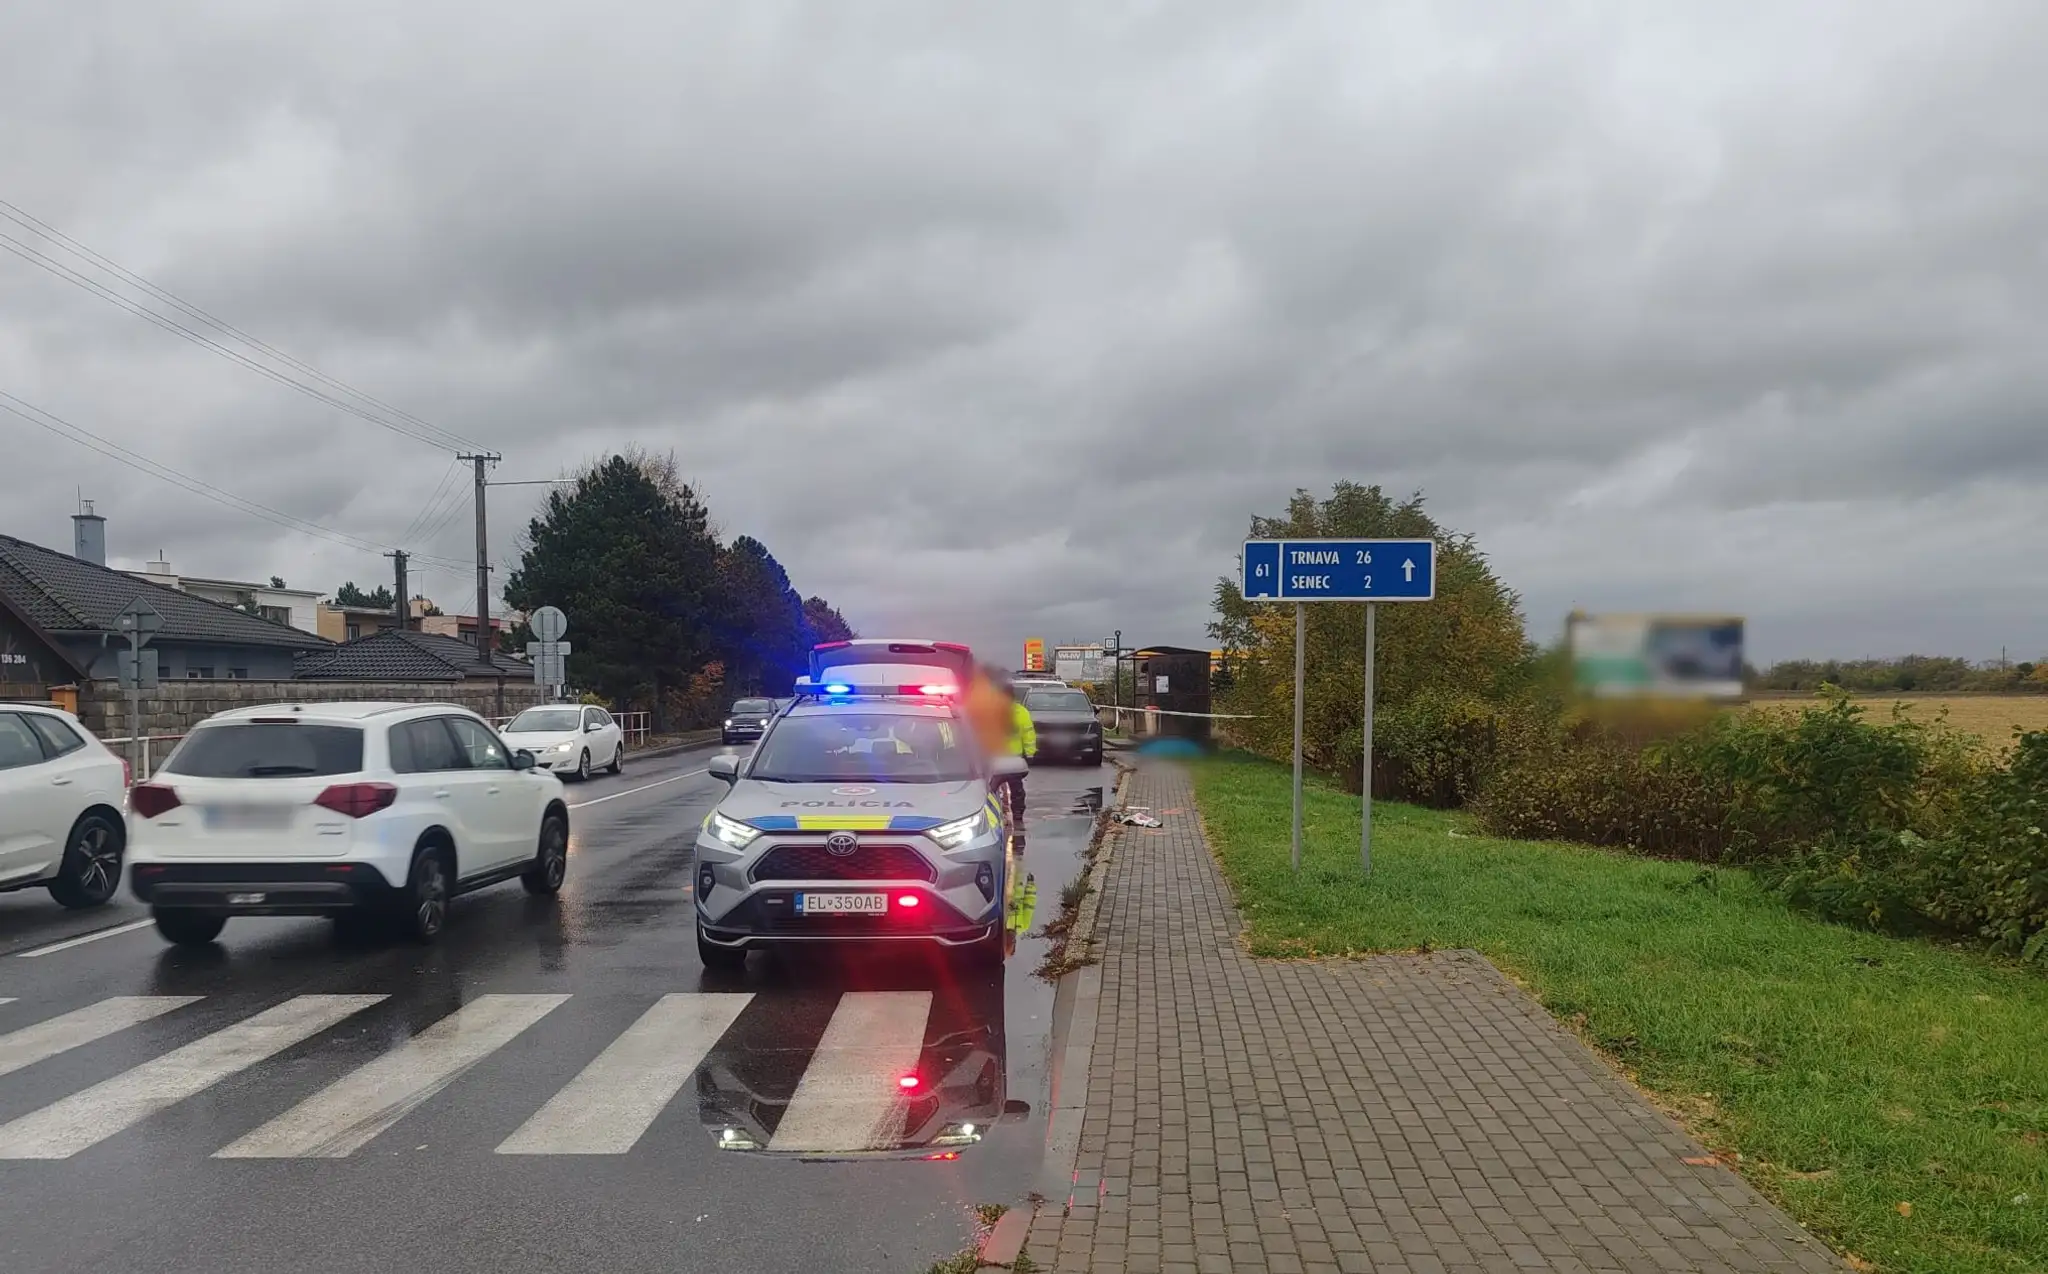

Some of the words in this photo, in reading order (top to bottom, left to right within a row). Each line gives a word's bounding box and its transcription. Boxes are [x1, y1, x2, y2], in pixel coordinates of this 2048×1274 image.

[1290, 551, 1340, 565] TRNAVA
[1356, 550, 1372, 565] 26
[1255, 563, 1270, 577] 61
[1291, 575, 1331, 589] SENEC
[1364, 575, 1372, 589] 2
